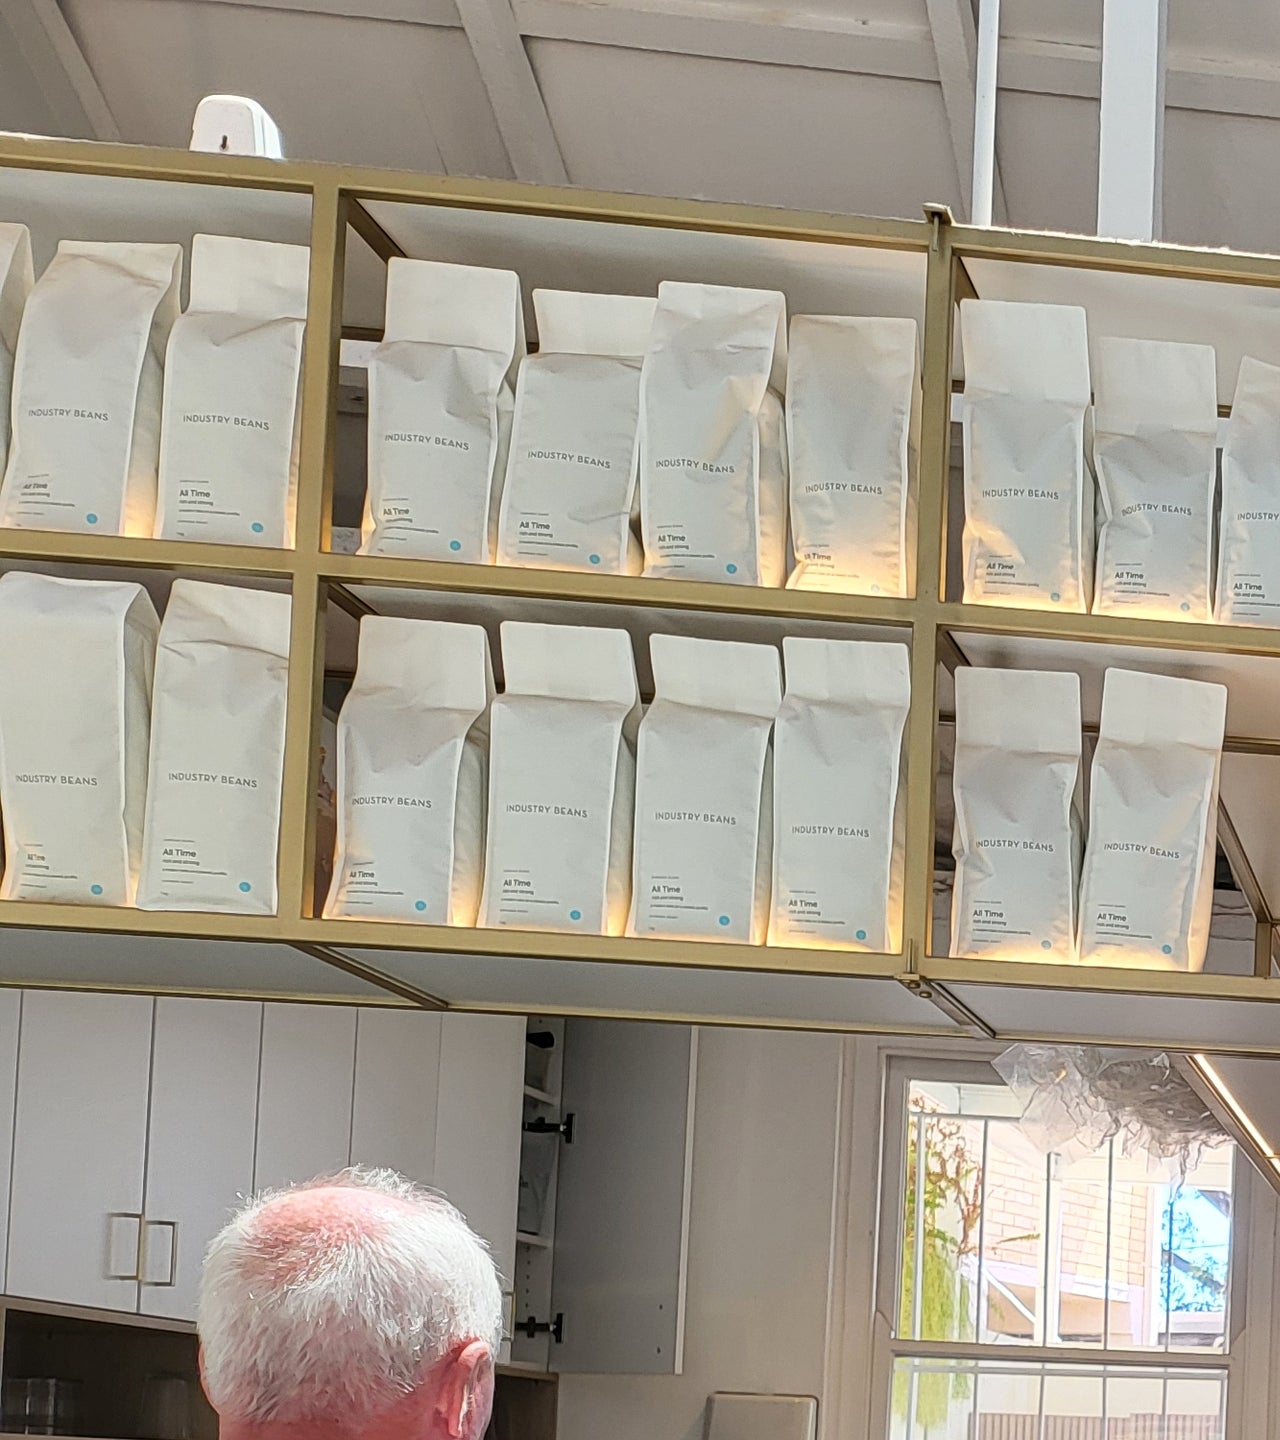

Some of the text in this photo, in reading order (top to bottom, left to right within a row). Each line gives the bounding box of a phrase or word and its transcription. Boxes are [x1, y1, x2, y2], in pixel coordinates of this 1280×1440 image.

[28, 408, 109, 421] INDUSTRY BEANS
[183, 414, 270, 431] INDUSTRY BEANS
[385, 433, 470, 451] INDUSTRY BEANS
[527, 451, 611, 469] INDUSTRY BEANS
[655, 458, 735, 473] INDUSTRY BEANS
[805, 482, 883, 495] INDUSTRY BEANS
[982, 488, 1060, 501] INDUSTRY BEANS
[1121, 503, 1192, 517] INDUSTRY BEANS
[1237, 512, 1280, 522] INDUSTRY
[16, 774, 98, 786] INDUSTRY BEANS
[168, 773, 258, 788] INDUSTRY BEANS
[352, 796, 432, 808] INDUSTRY BEANS
[506, 804, 588, 818] INDUSTRY BEANS
[655, 812, 736, 825] INDUSTRY BEANS
[792, 825, 870, 838] INDUSTRY BEANS
[976, 839, 1054, 852] INDUSTRY BEANS
[1104, 843, 1180, 859] INDUSTRY BEANS
[984, 909, 1004, 919] Time
[1107, 913, 1127, 922] Time
